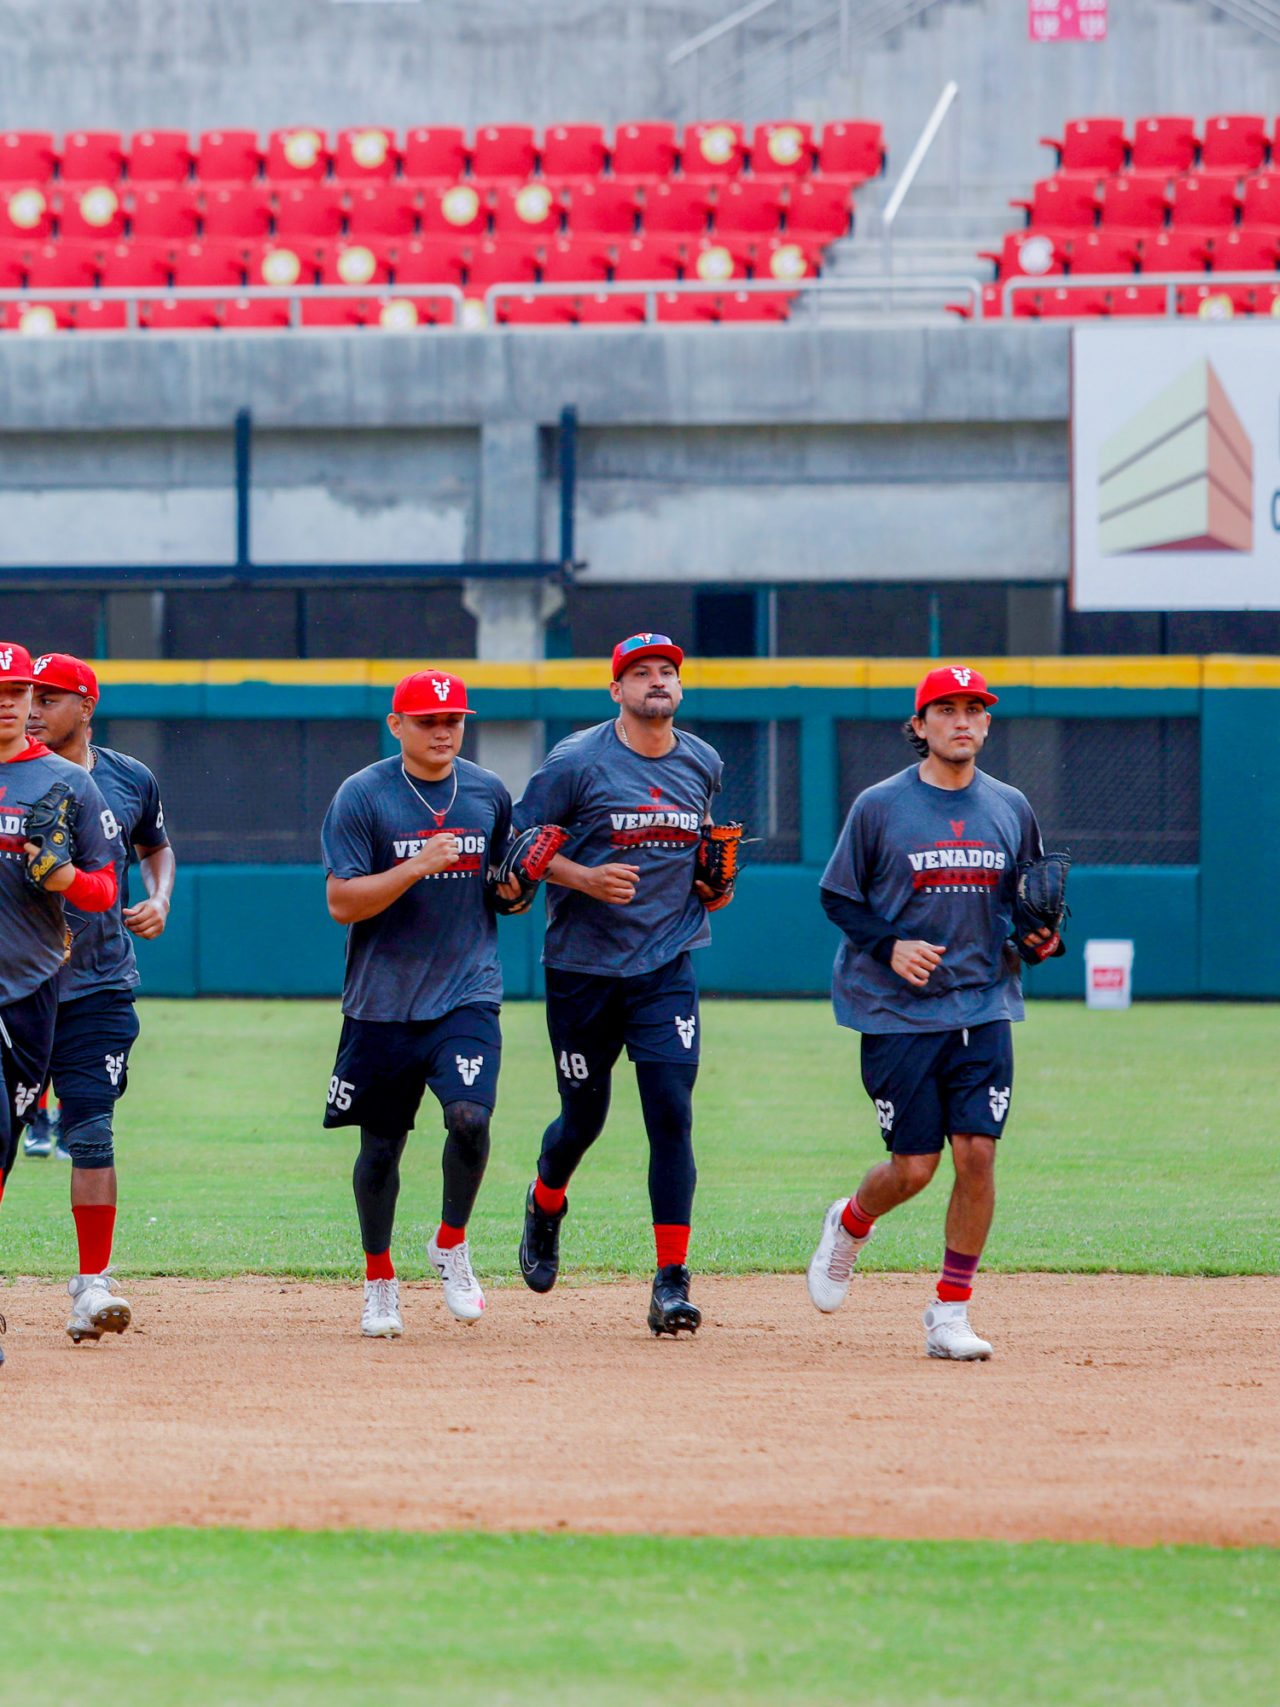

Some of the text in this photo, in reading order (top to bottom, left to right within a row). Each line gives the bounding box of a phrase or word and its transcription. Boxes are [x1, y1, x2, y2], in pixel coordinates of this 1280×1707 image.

[610, 813, 699, 831] VENADOS
[393, 836, 486, 858] VEDOS
[907, 849, 1006, 871] VENADOS
[559, 1050, 589, 1080] 48
[327, 1075, 356, 1111] 95
[874, 1098, 895, 1131] 62
